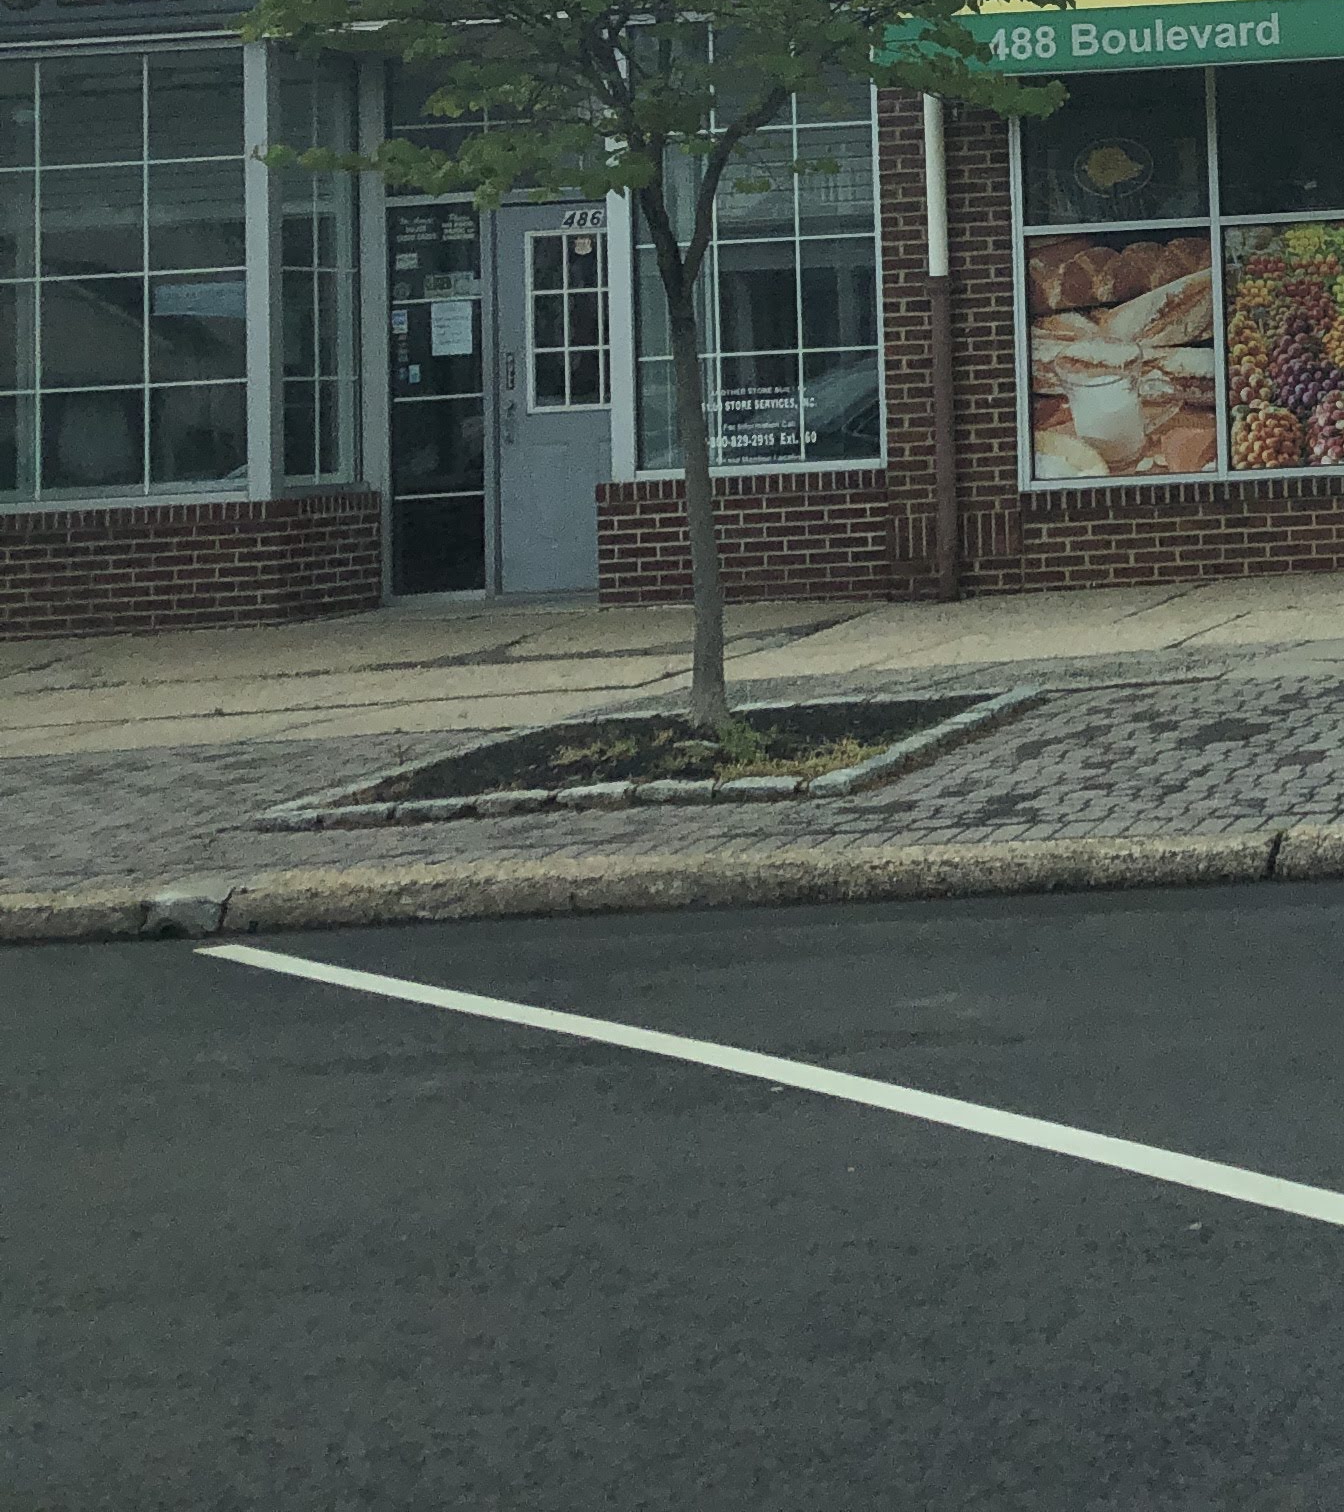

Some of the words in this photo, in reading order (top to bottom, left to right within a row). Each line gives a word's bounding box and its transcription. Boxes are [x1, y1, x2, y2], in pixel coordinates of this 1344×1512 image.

[990, 25, 1056, 61] 488
[1071, 11, 1280, 57] Boulevard
[562, 210, 604, 229] 486
[724, 399, 752, 411] STORE
